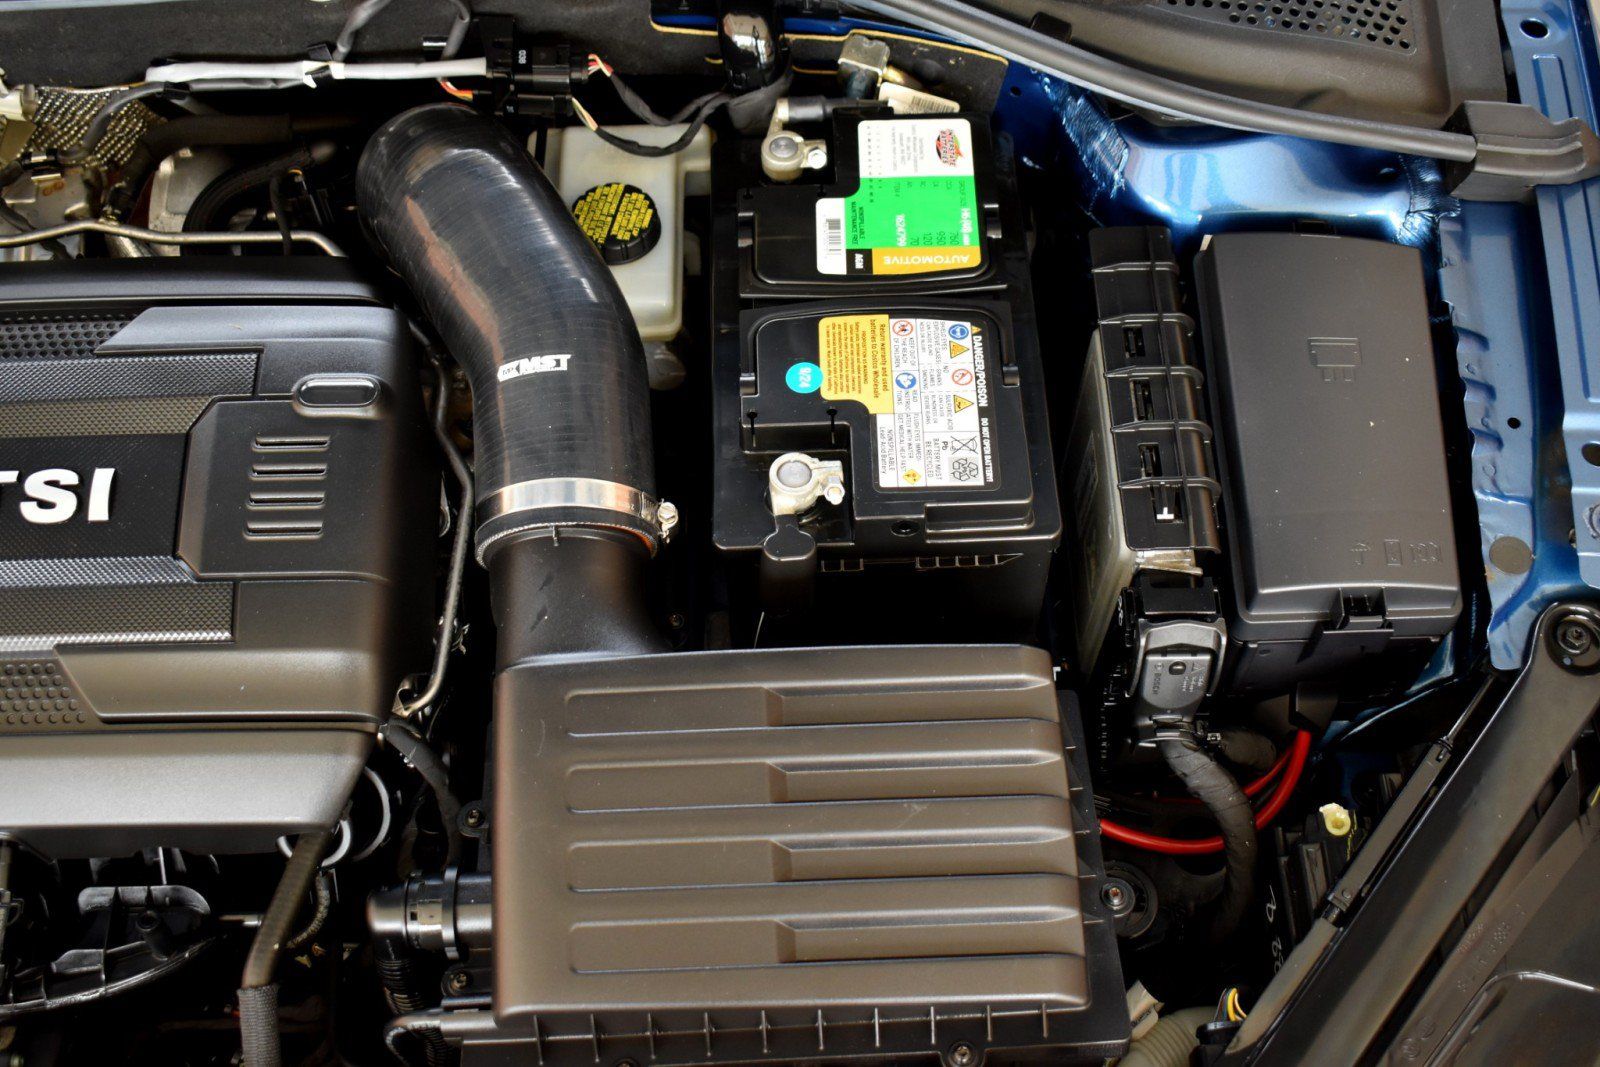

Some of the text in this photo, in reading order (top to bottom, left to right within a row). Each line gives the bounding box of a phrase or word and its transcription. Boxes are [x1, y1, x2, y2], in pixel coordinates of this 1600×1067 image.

[910, 237, 920, 246] 70
[923, 233, 933, 246] 120
[936, 231, 946, 246] 950
[949, 232, 960, 246] 760
[854, 253, 864, 269] AGM
[883, 254, 970, 266] AUTOMOTIVE
[869, 319, 878, 343] batteries
[519, 354, 572, 374] MST
[871, 350, 879, 369] Costco
[972, 335, 988, 407] DANGER/POISON
[981, 417, 989, 426] DO
[982, 427, 990, 438] NOT
[887, 429, 896, 471] NONSPILLABLE
[933, 438, 941, 463] BATTERY
[942, 441, 949, 451] Pb
[983, 438, 991, 454] OPEN
[926, 449, 934, 478] RECYCLED
[1152, 673, 1161, 695] BOSCH
